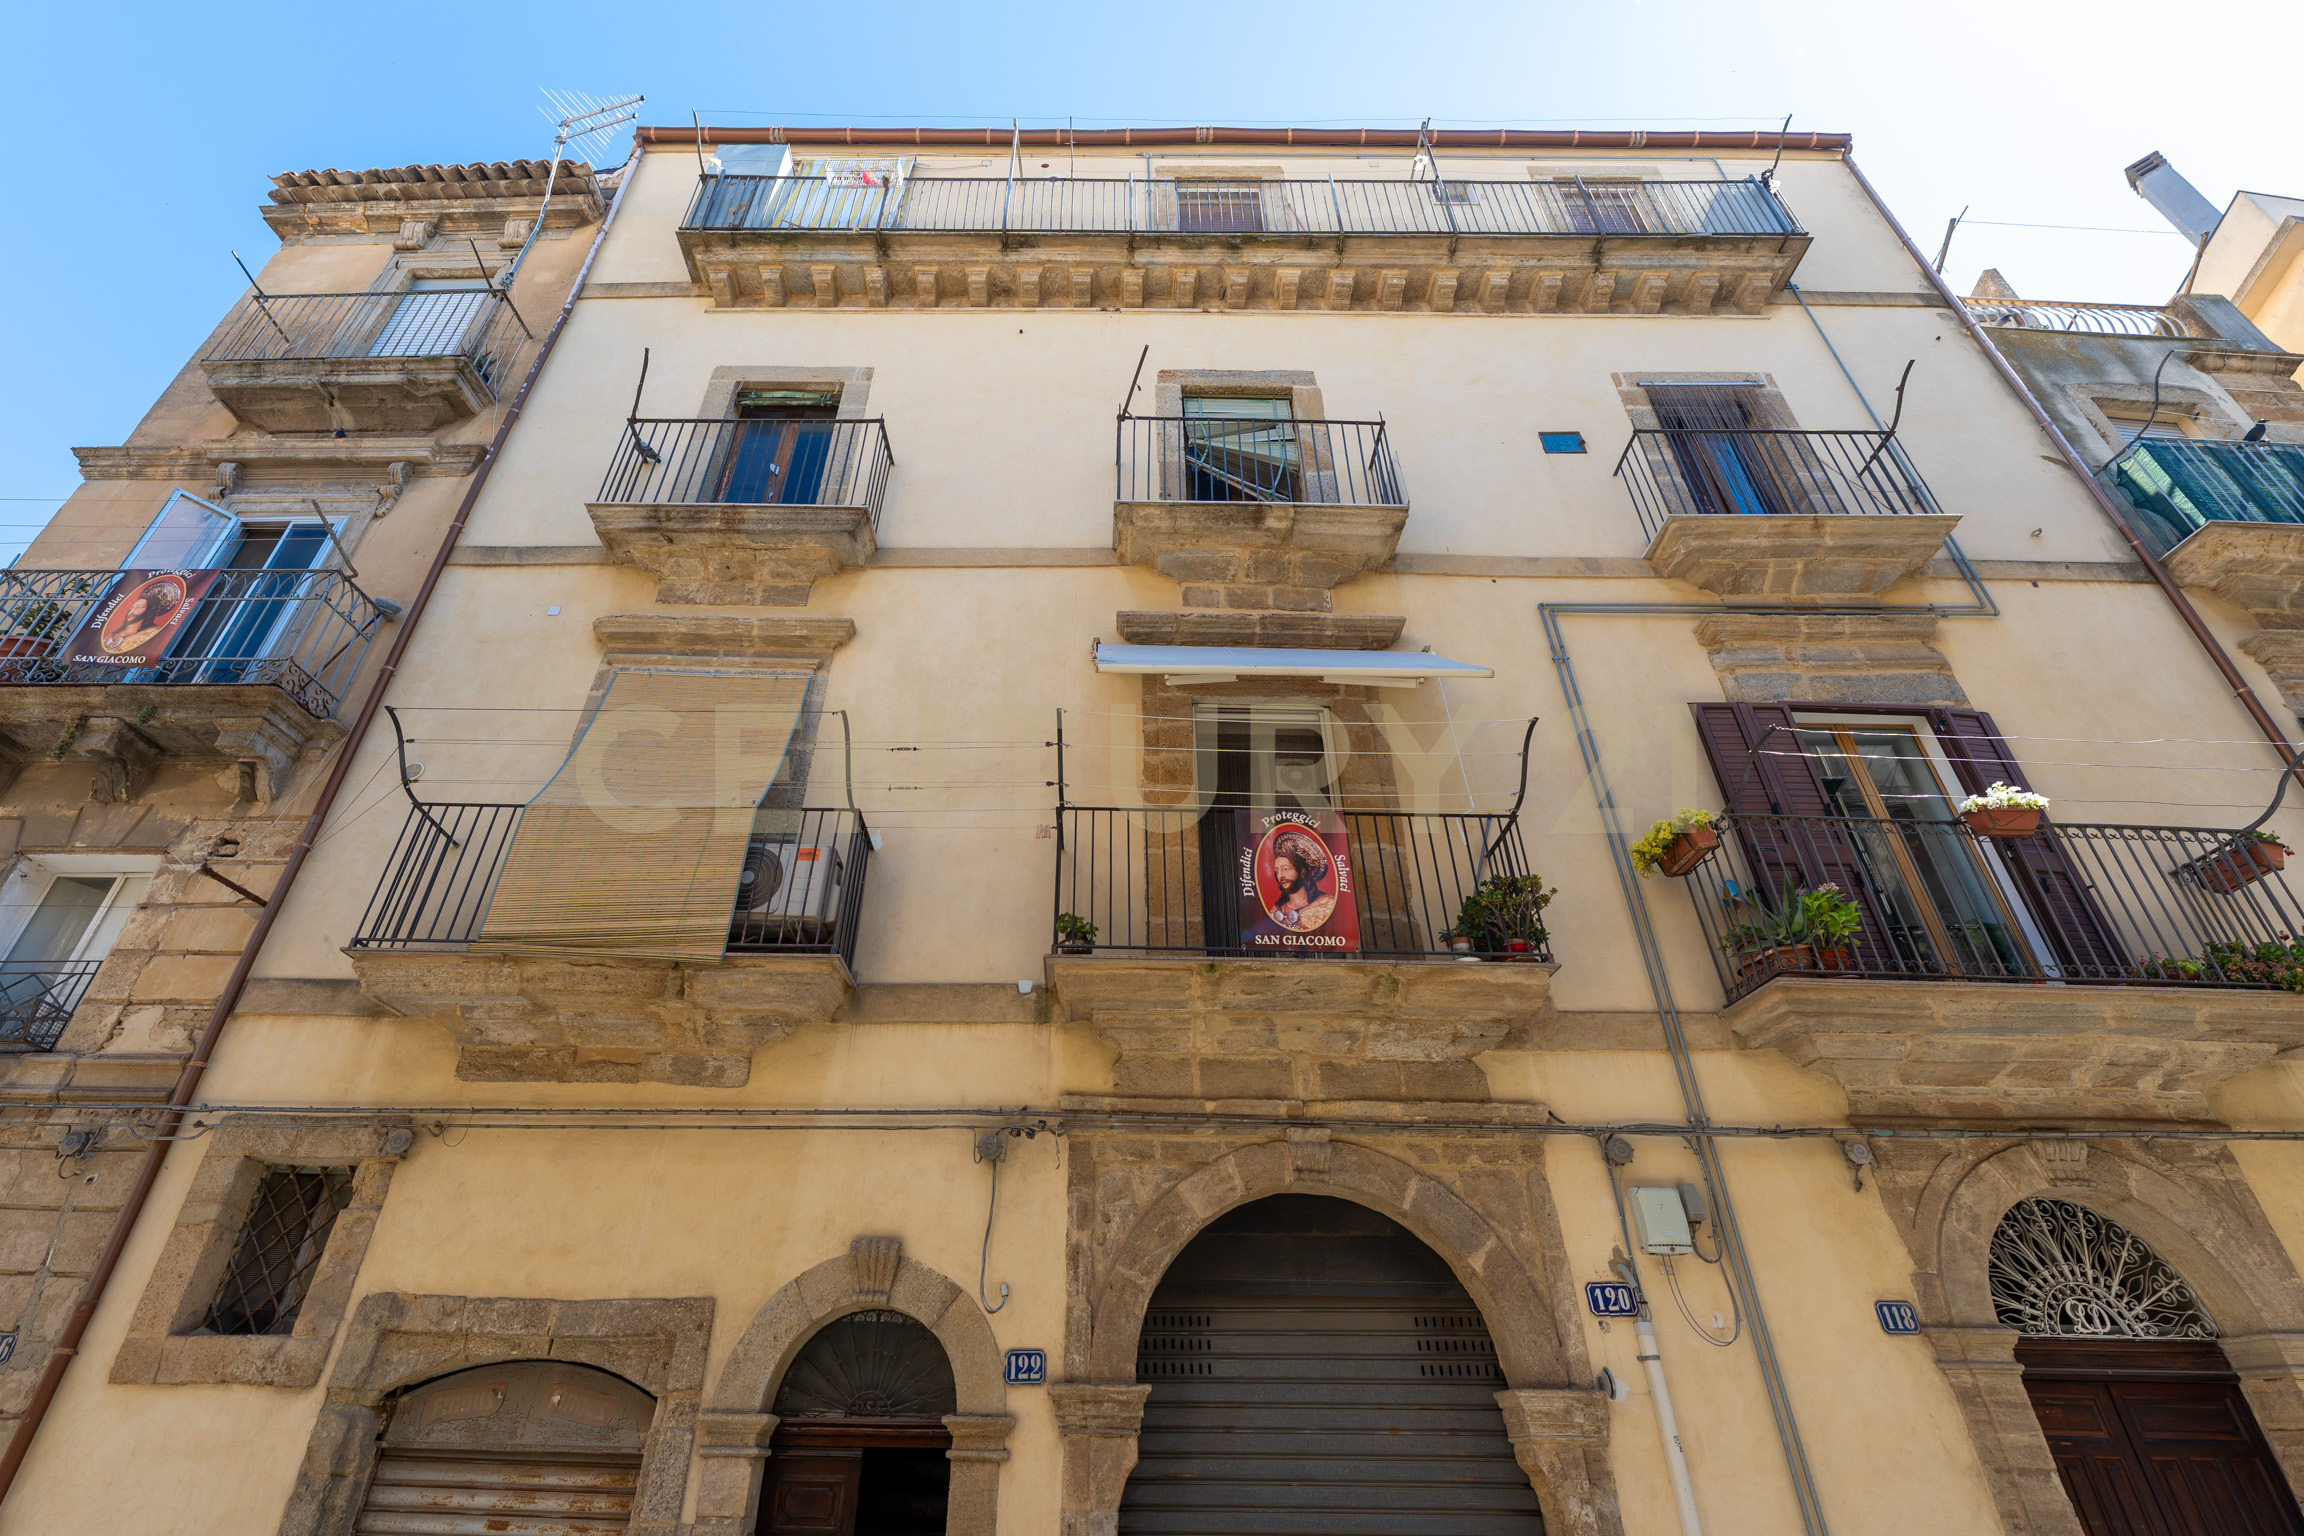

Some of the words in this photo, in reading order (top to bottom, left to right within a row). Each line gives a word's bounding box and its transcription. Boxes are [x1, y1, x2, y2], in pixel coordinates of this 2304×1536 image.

[91, 593, 125, 629] Difendici
[170, 597, 194, 626] Salvaci
[72, 654, 98, 663] SAN
[96, 655, 147, 664] GIACOMO
[1261, 811, 1321, 828] Proteggici
[1239, 847, 1256, 897] Difendici
[1334, 854, 1351, 893] Salvaci
[1255, 934, 1281, 945] SAN
[1282, 935, 1346, 947] GIACOMO
[1594, 1287, 1631, 1311] 120
[1882, 1305, 1915, 1330] 118
[1009, 1354, 1042, 1380] 122
